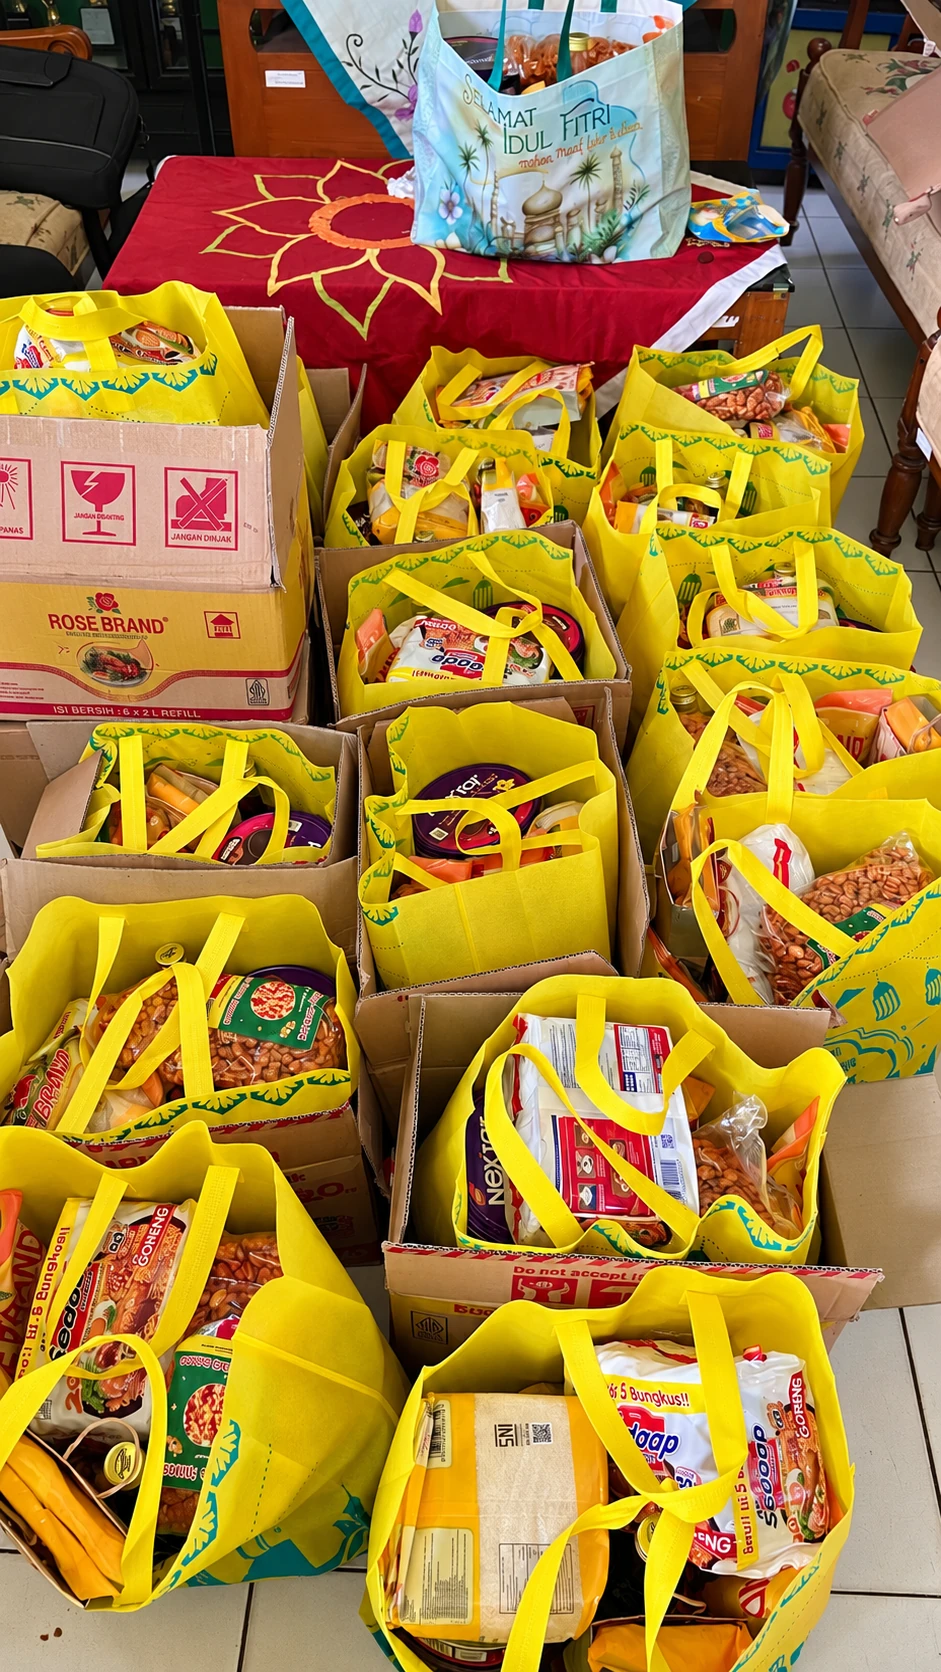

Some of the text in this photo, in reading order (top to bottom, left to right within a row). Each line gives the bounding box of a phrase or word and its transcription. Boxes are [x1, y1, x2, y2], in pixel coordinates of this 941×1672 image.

[462, 73, 537, 128] SELAMAT
[503, 98, 611, 155] IDUL FITRI
[170, 533, 232, 544] JANGAN DINJAK
[48, 614, 165, 635] ROSE BRAND
[53, 705, 69, 714] ISI
[71, 706, 114, 716] BERSIH
[123, 708, 130, 716] 6
[142, 709, 150, 717] 2
[152, 709, 159, 717] L
[161, 709, 201, 719] REFILL
[32, 1048, 71, 1120] BRAND
[513, 1266, 536, 1275] Do
[540, 1268, 566, 1277] not
[570, 1269, 627, 1282] accept
[629, 1386, 690, 1408] Bungkus!!
[790, 1376, 811, 1439] GORENG
[497, 1423, 515, 1448] SNI
